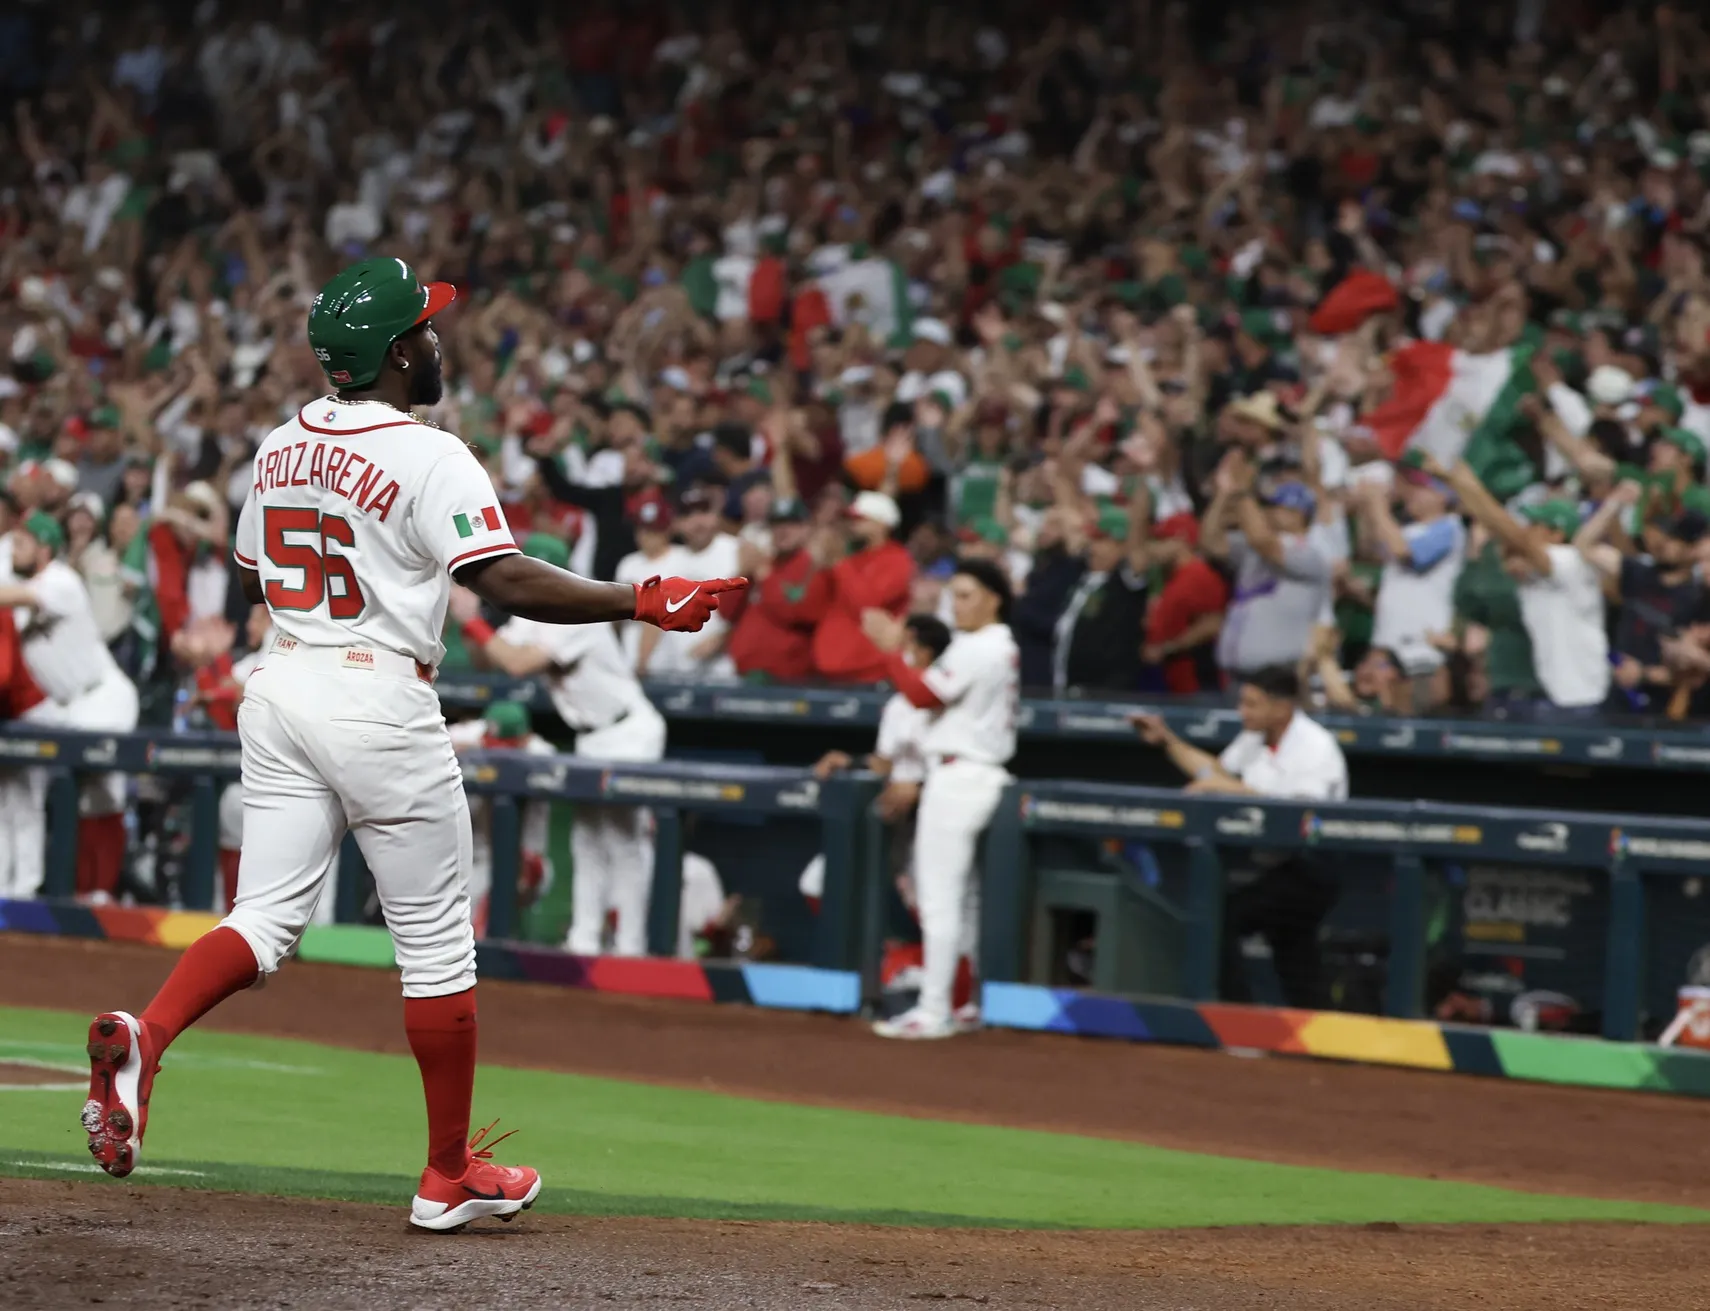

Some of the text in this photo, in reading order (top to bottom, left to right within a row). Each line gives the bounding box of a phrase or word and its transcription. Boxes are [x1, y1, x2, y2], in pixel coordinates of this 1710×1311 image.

[315, 347, 331, 361] 56
[254, 441, 400, 523] AROZARENA
[263, 506, 366, 619] 56
